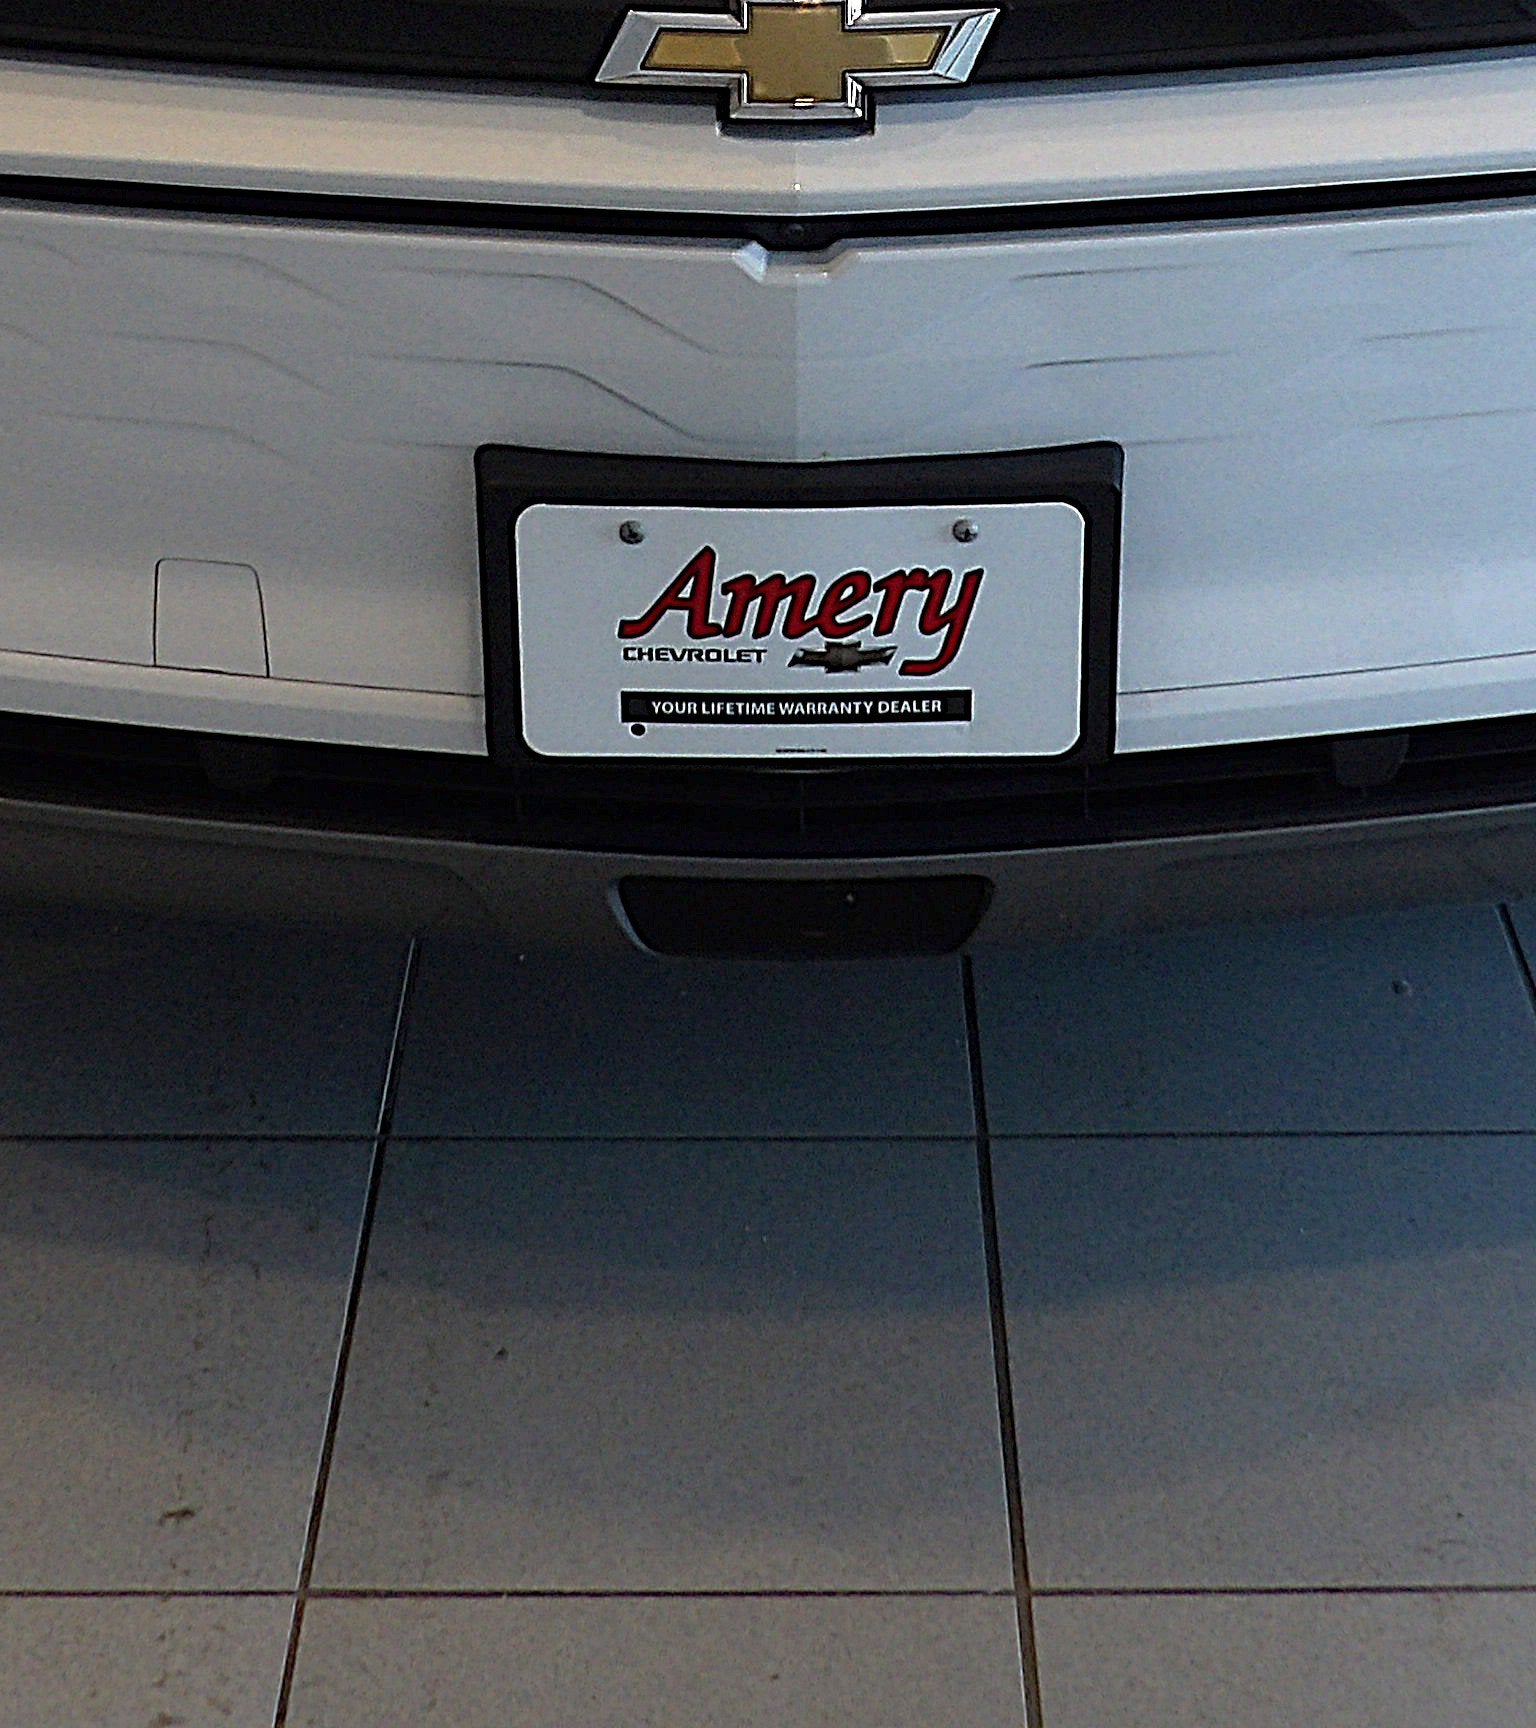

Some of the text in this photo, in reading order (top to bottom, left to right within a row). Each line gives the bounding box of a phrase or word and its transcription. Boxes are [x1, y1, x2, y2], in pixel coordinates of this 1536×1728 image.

[617, 545, 985, 677] Amery
[622, 647, 768, 664] CHEVROLET
[652, 699, 942, 716] YOUR LIFETIME WARRANTY DEALER
